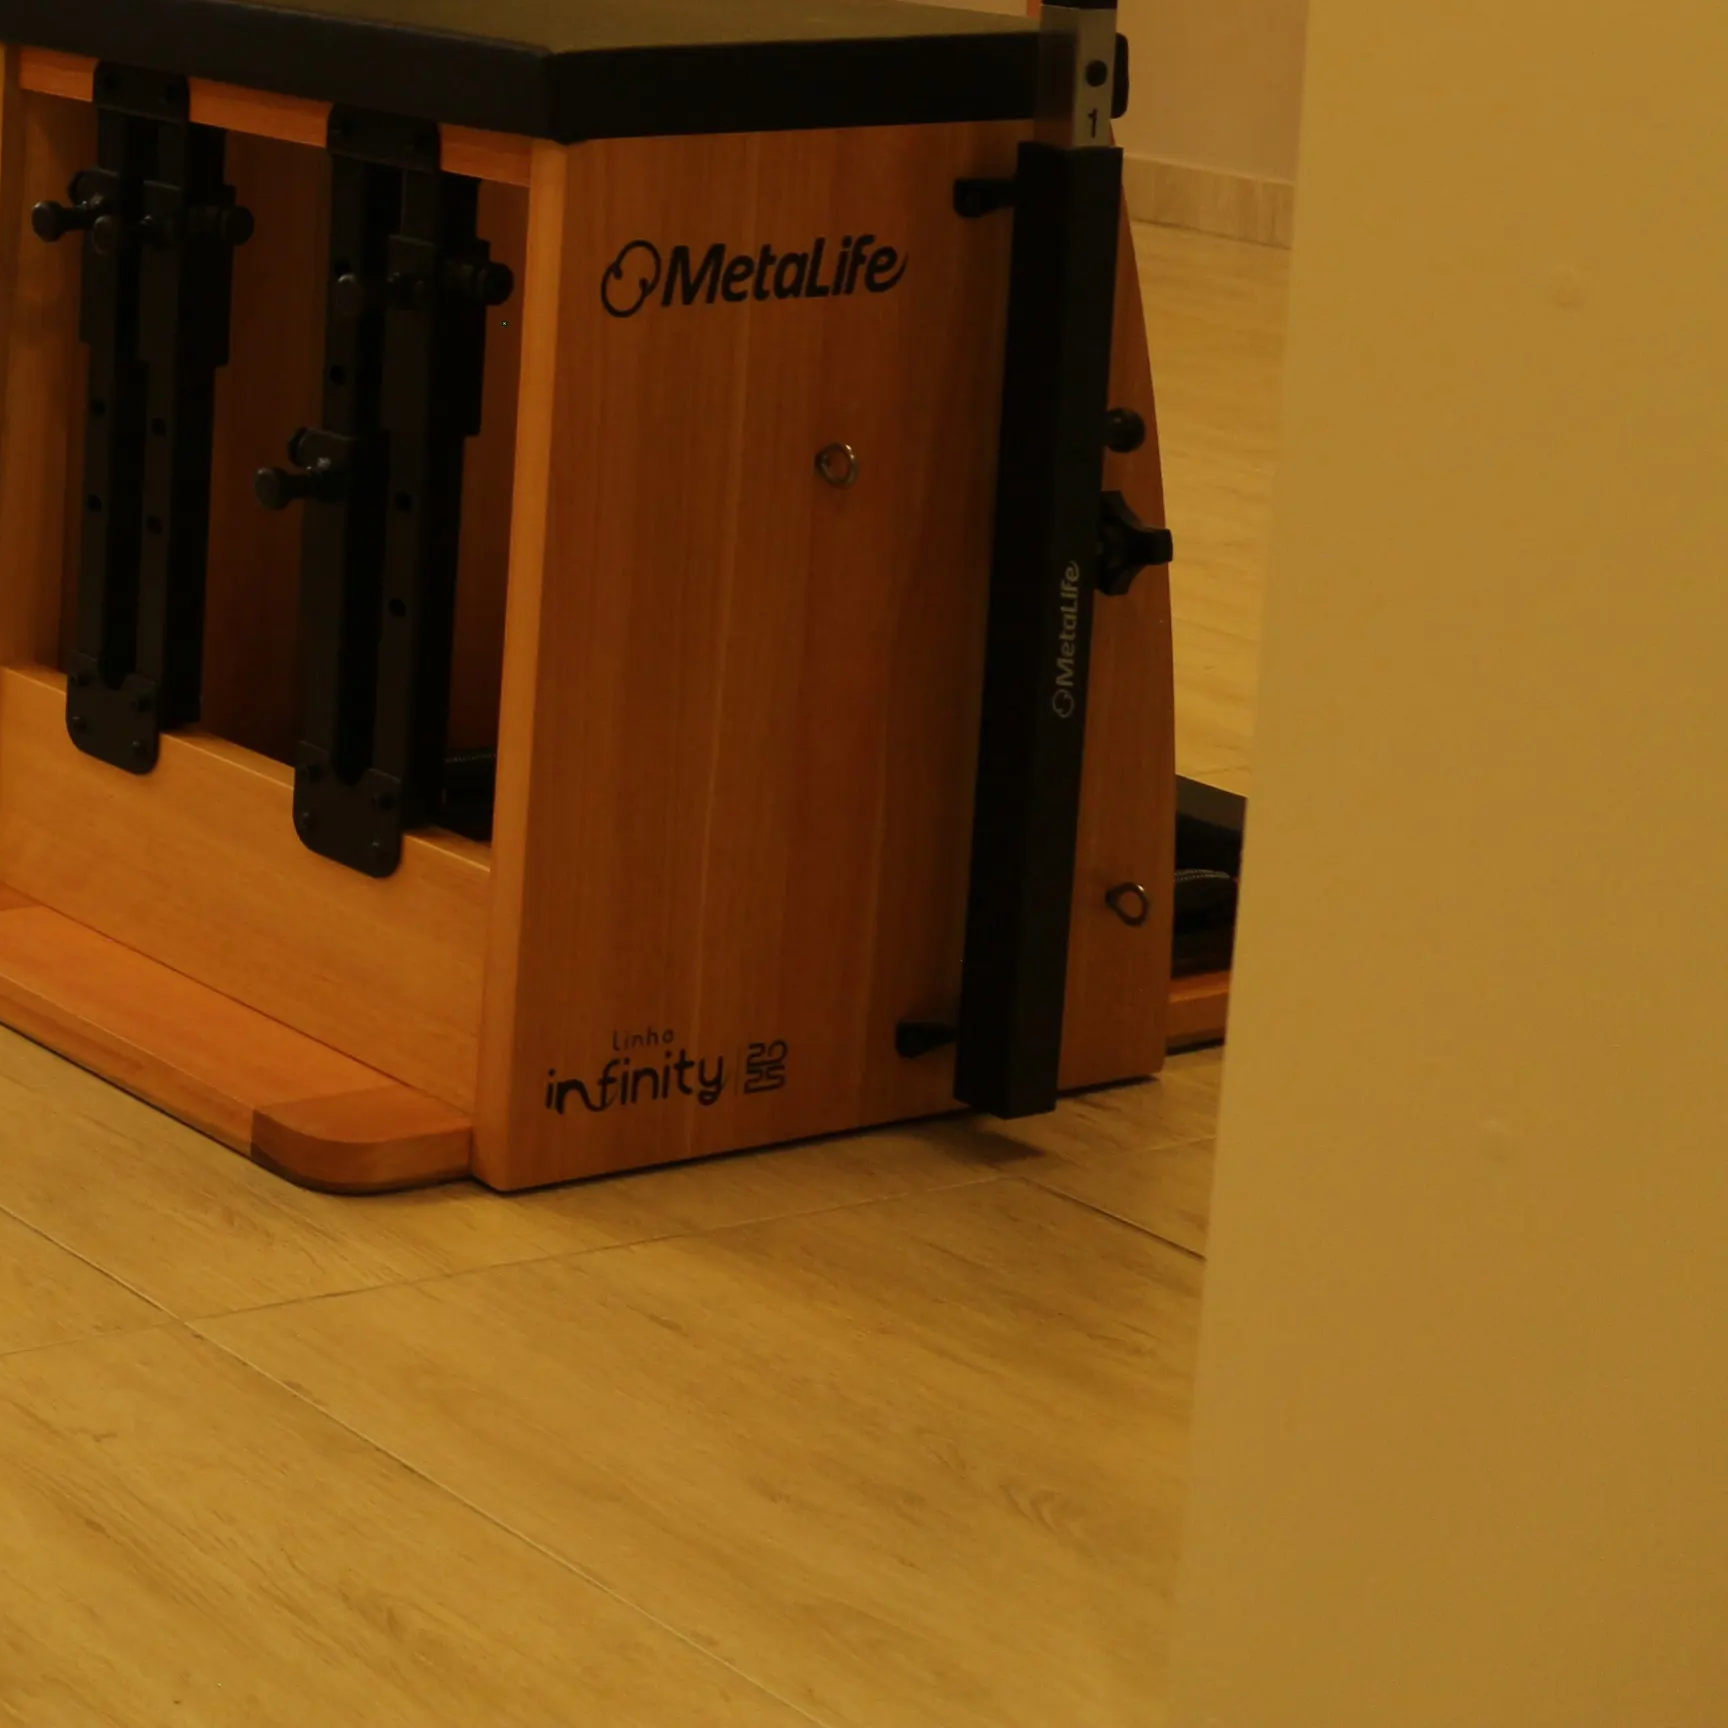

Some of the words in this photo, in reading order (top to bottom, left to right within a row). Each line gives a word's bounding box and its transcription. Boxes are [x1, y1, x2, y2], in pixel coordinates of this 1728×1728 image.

[661, 234, 910, 307] MetaLife
[1055, 559, 1081, 687] MetaLife
[545, 1049, 726, 1114] infinity
